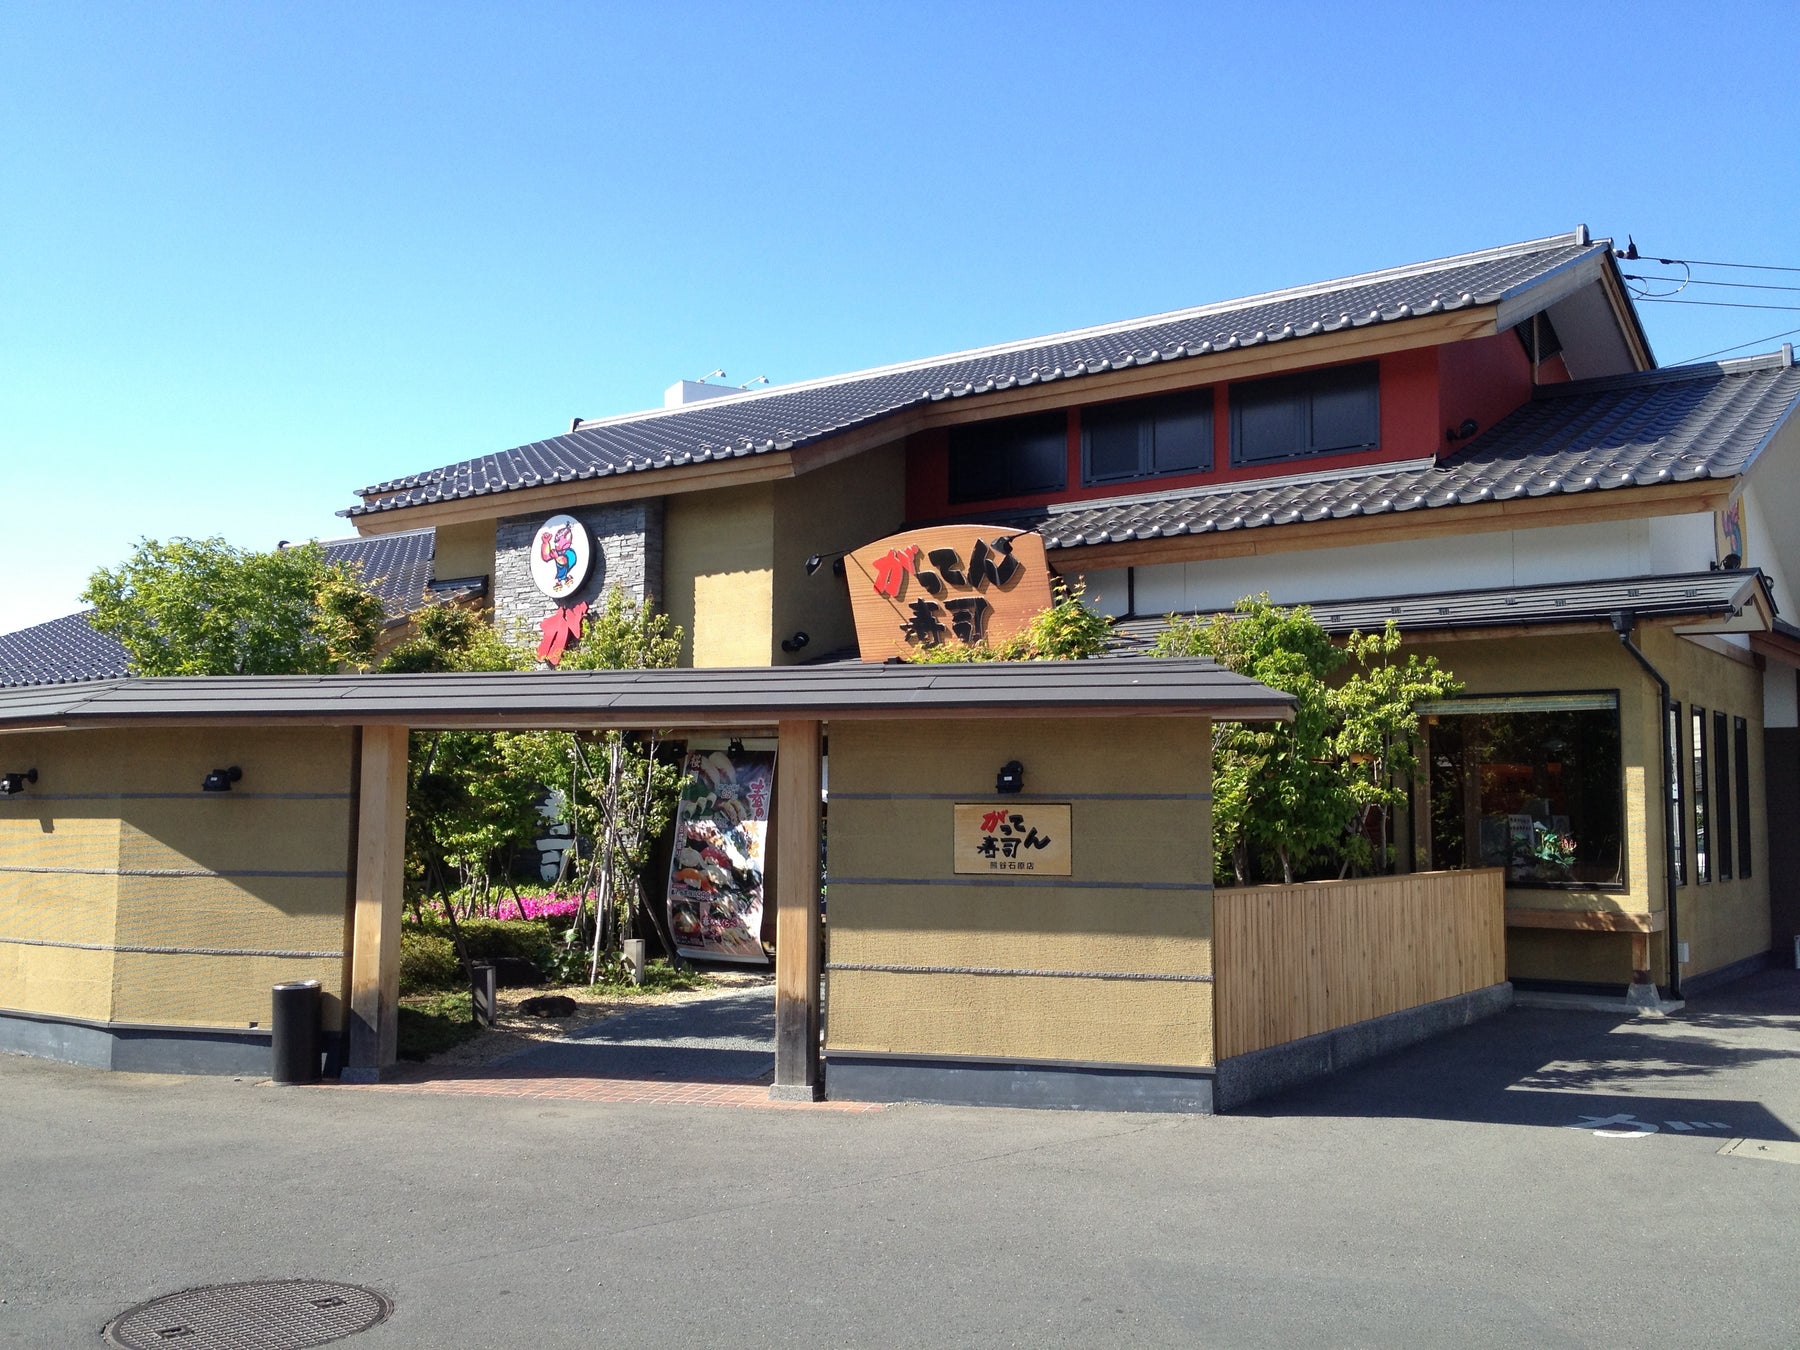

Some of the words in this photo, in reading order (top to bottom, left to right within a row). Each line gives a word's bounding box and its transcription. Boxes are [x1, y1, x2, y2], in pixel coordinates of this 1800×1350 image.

[873, 538, 1020, 597] がってん
[899, 597, 989, 649] 寿司
[976, 835, 1022, 859] 寿司
[980, 809, 1051, 850] がってん
